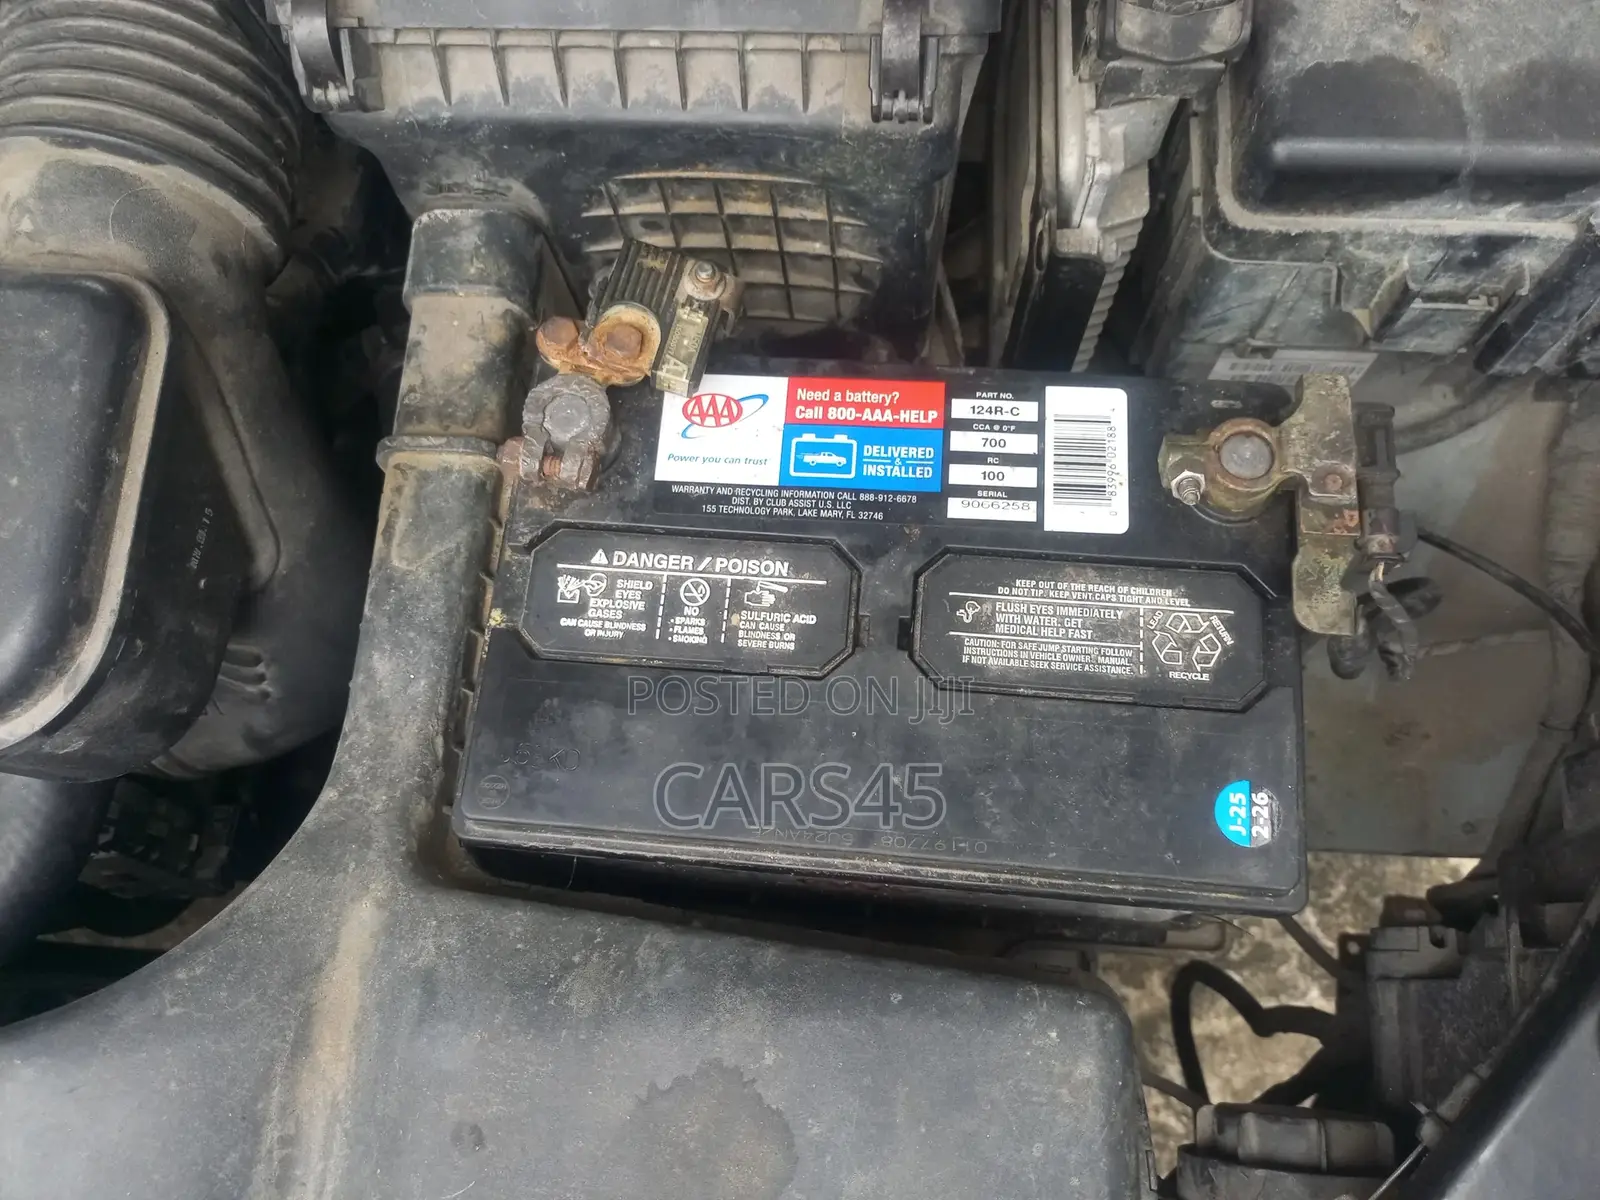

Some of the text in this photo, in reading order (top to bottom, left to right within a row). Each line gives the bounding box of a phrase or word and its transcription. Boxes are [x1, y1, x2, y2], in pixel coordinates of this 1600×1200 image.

[796, 388, 900, 406] Need a battery?
[975, 391, 1014, 400] PART NO.
[686, 394, 739, 428] AAA
[795, 405, 938, 424] Call 800-AAA-HELP
[969, 405, 1021, 417] 124R-C
[972, 423, 992, 431] CCA
[981, 437, 1007, 449] 700
[1106, 425, 1117, 459] 02188
[863, 444, 935, 459] DELIVERED
[667, 453, 768, 466] Power you can trust
[894, 457, 902, 466] &
[862, 464, 933, 479] INSTALLED
[980, 471, 1005, 482] 100
[1106, 463, 1117, 497] 83996
[671, 484, 917, 504] WARRANTY AND RECYCLING INFORMATION CALL 888-912-6678
[976, 490, 1008, 498] SERIAL
[731, 496, 852, 510] DIST. BY CLUB ASSIST U.S. LLC
[702, 504, 884, 521] 155 TECHNOLOGY PARK, LAKE MARY, FL 32746
[612, 550, 789, 577] DANGER / POISON
[615, 579, 654, 591] SHIELD
[1015, 579, 1173, 597] KEEP OUT OF THE REACH OF CHILDREN
[614, 589, 642, 600] EYES
[997, 586, 1010, 595] DO
[1011, 587, 1029, 596] NOT
[1031, 588, 1047, 597] TIP.
[1049, 590, 1070, 599] KEEP
[1095, 593, 1117, 602] CAPS
[1119, 594, 1144, 604] TIGHT
[1145, 596, 1162, 605] AND
[1165, 597, 1191, 607] LEVEL
[589, 598, 646, 611] EXPLOSIVE
[683, 606, 700, 616] NO
[995, 602, 1124, 620] FLUSH EYES IMMEDIATELY
[587, 608, 623, 620] GASES
[674, 616, 706, 627] SPARKS
[740, 610, 817, 625] SULFURIC ACID
[995, 613, 1084, 629] WITH WATER. GET
[1147, 610, 1164, 630] LEAD
[559, 617, 647, 632] CAN CAUSE BLINDNESS
[673, 625, 705, 635] FLAMES
[739, 621, 785, 632] CAN CAUSE
[995, 624, 1093, 640] MEDICAL HELP FAST
[1209, 615, 1235, 646] RETURN
[584, 629, 624, 640] OR INJURY
[672, 634, 708, 645] SMOKING
[738, 630, 796, 642] BLINDNESS OR
[737, 639, 795, 651] SEVERE BURNS
[964, 638, 1133, 657] CAUTION: FOR SAFE JUMP STARTING FOLLOW
[963, 646, 1018, 659] INSTRUCTIONS
[1020, 650, 1029, 659] IN
[1030, 651, 1061, 661] VEHICLE
[1098, 656, 1133, 666] MANUAL.
[962, 655, 1134, 675] IF NOT AVAILABLE SEEK SERVICE ASSISTANCE.
[1169, 671, 1210, 681] RECYCLE
[1228, 792, 1247, 837] J-25
[1251, 792, 1269, 839] 2-26
